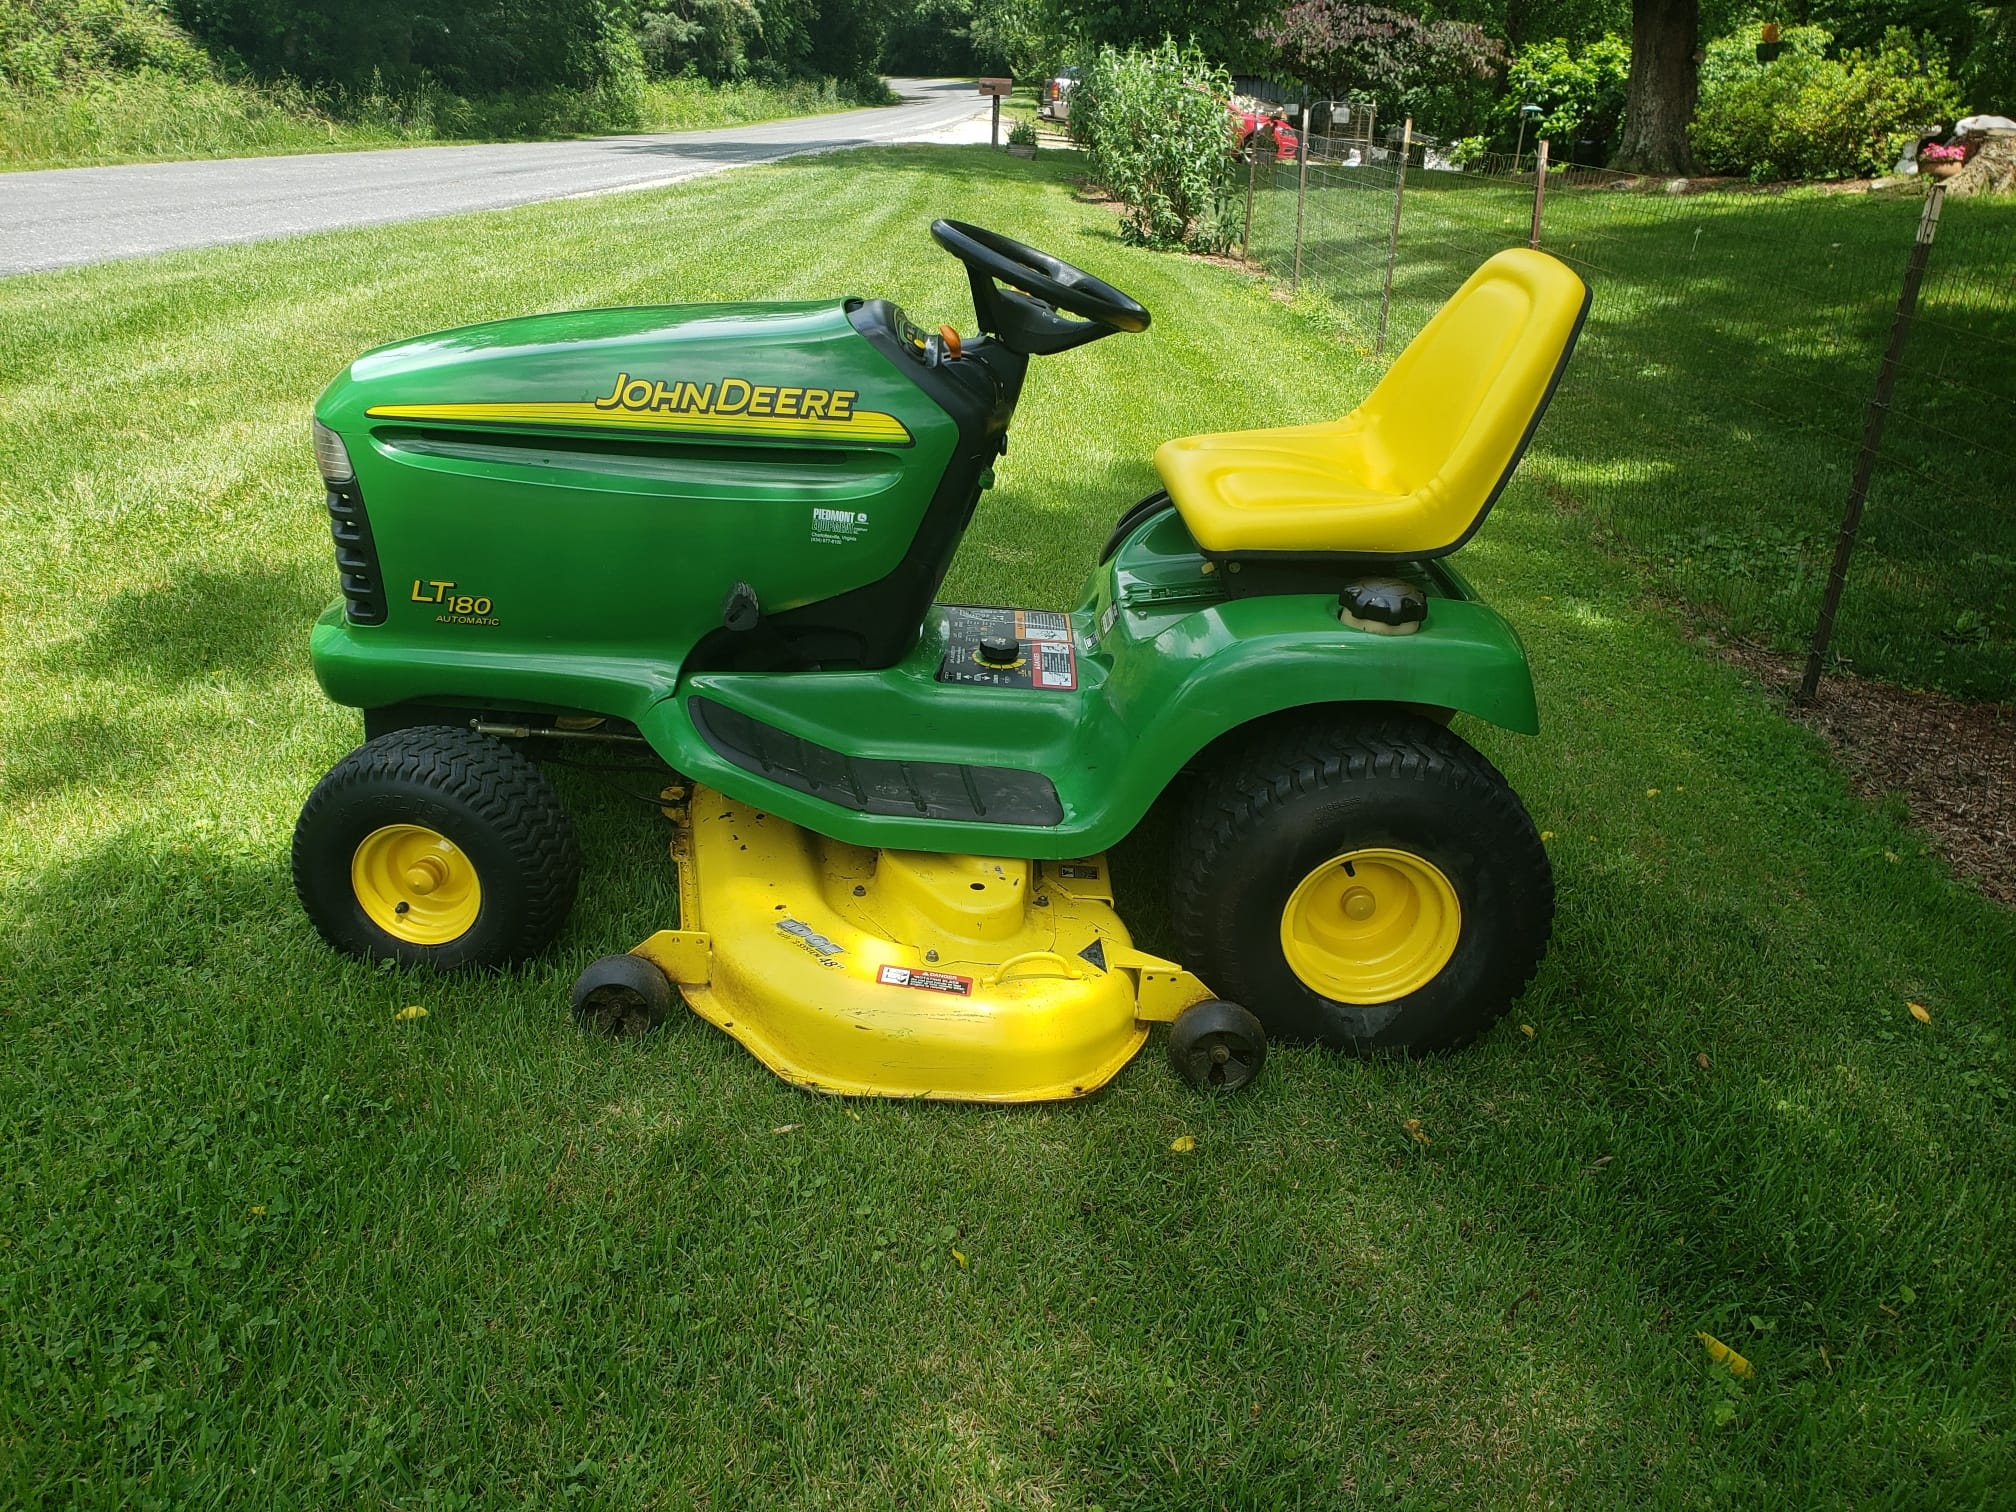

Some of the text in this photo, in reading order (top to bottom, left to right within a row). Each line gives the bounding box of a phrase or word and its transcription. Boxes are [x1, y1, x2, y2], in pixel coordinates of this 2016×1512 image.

[595, 372, 858, 421] JOHN DEERE
[812, 507, 856, 523] PIEDMONT
[435, 615, 500, 626] AUTOMATIC
